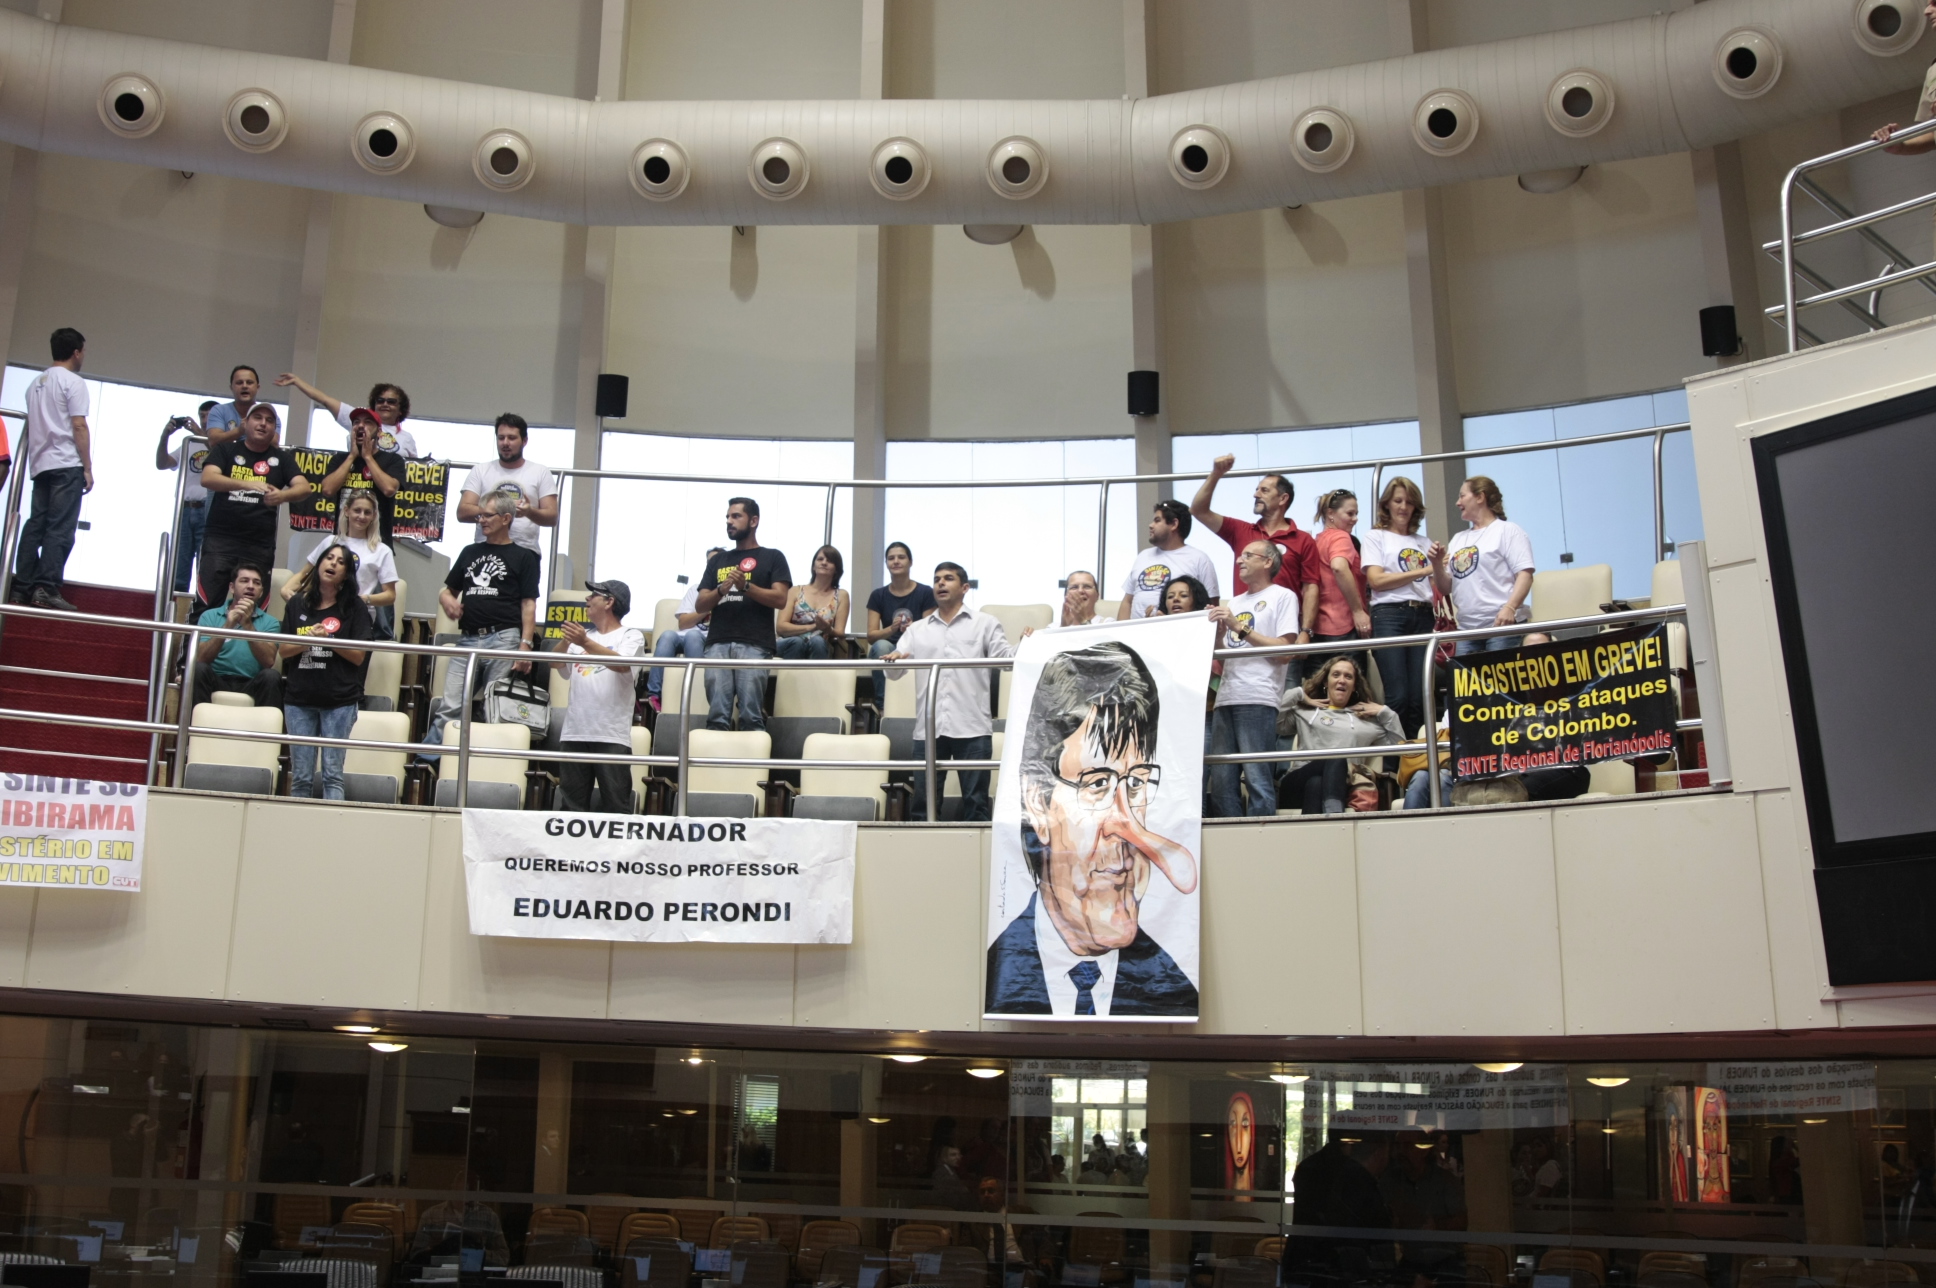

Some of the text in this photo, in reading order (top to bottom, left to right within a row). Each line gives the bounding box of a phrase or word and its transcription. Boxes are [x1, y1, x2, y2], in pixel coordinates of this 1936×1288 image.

[232, 464, 254, 477] BASTA
[405, 463, 445, 486] REVE!
[344, 480, 373, 489] OLOMBO!
[315, 499, 335, 513] de
[290, 513, 318, 530] SINTE
[1453, 636, 1663, 697] MAGISTÉRIO EM GREVE!
[1458, 678, 1668, 723] Contra os ataques
[1491, 712, 1638, 746] de Colombo.
[1457, 729, 1672, 777] SINTE Regional de Florianópolis
[4, 773, 139, 797] SINTE SC
[1, 799, 136, 831] IBIRAMA
[544, 817, 747, 842] GOVERNADOR
[97, 840, 134, 861] EM
[504, 857, 800, 877] QUEREMOS NOSSO PROFESSOR
[513, 897, 791, 922] EDUARDO PERONDI
